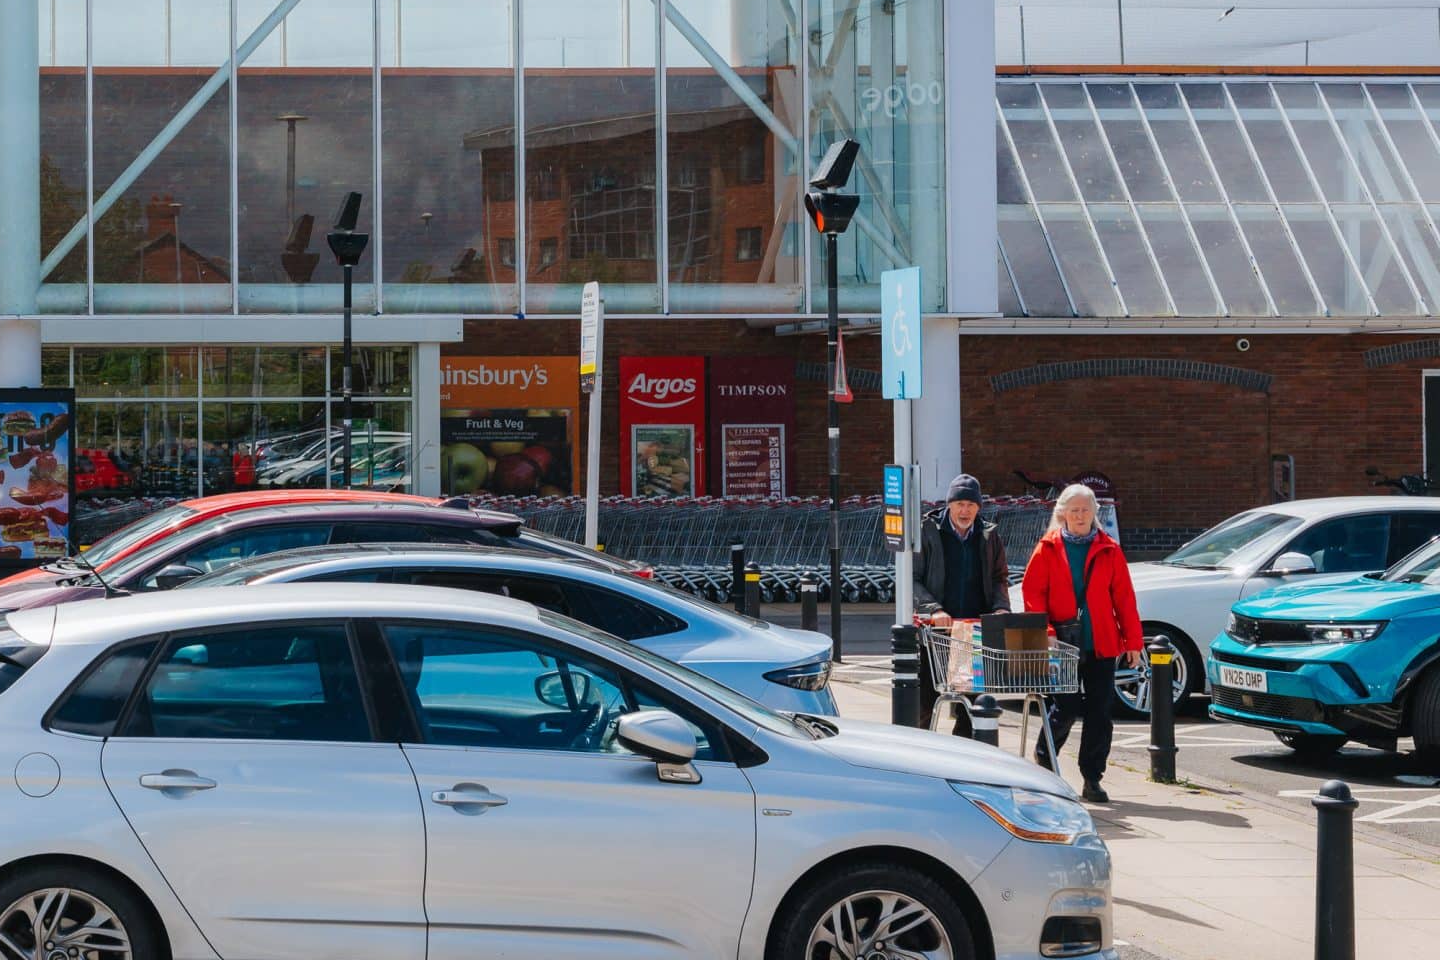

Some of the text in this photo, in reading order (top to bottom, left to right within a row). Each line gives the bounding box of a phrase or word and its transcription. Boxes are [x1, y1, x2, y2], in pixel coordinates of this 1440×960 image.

[440, 363, 548, 390] insbury's
[627, 373, 696, 399] Argos
[719, 384, 787, 396] TIMPSON
[466, 419, 524, 431] Fruit & Veg
